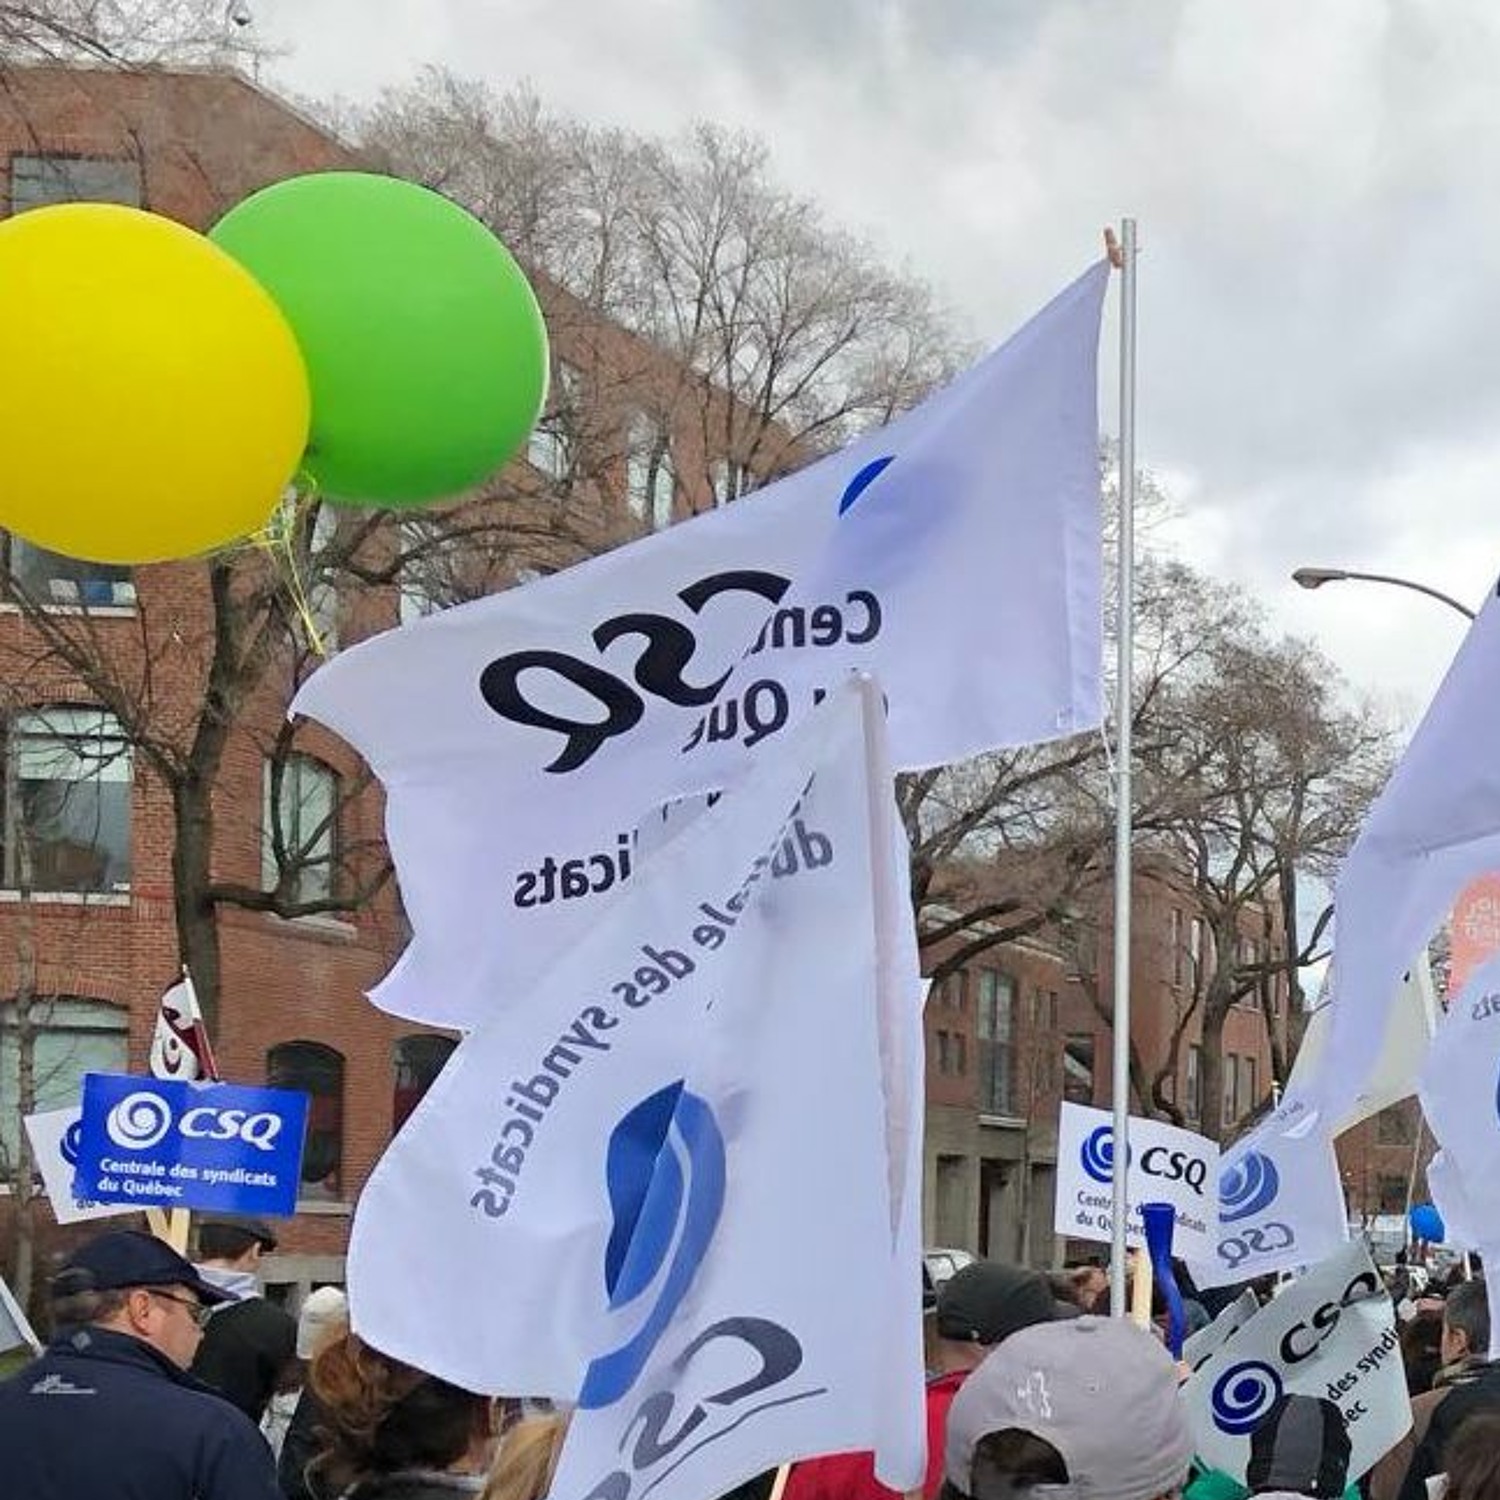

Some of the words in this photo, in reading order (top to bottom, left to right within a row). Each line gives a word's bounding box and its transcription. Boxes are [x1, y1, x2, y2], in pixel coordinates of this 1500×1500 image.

[178, 1106, 283, 1151] CSQ
[99, 1158, 166, 1178] Centrale
[169, 1162, 198, 1179] des
[202, 1165, 278, 1187] syndicats
[1139, 1146, 1208, 1195] CSQ
[97, 1176, 119, 1193] du
[122, 1178, 184, 1198] Québec
[1325, 1370, 1360, 1402] des
